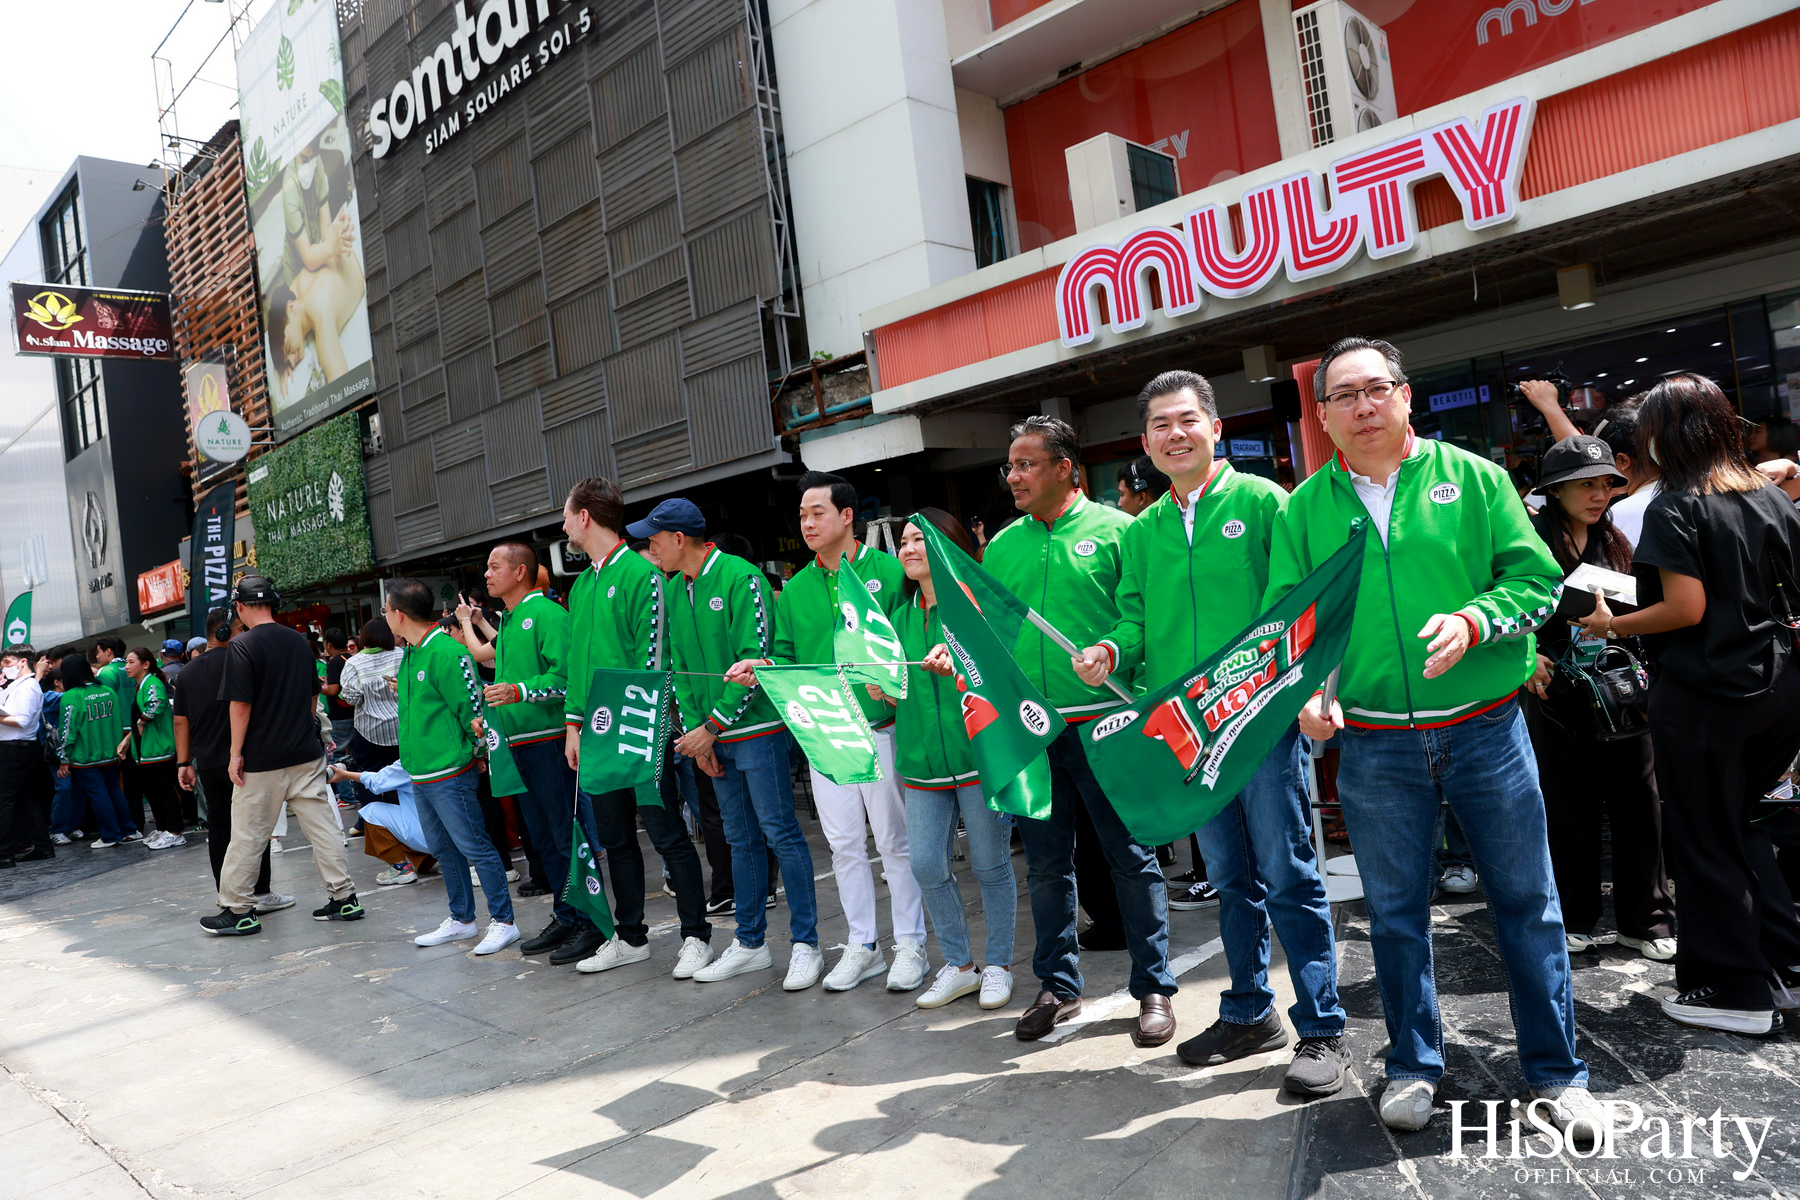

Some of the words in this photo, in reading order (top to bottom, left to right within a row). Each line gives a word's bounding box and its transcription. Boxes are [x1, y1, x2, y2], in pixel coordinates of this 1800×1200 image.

[425, 111, 460, 154] SIAM
[466, 54, 532, 122] SQUARE
[539, 23, 571, 64] SOI
[579, 7, 591, 33] 5
[273, 92, 307, 139] NATURE
[72, 330, 168, 355] Massage
[281, 414, 303, 432] Authentic
[303, 398, 330, 419] Traditional
[330, 390, 343, 405] Thai
[343, 377, 370, 397] Massage
[1233, 444, 1261, 452] FRAGRANCE
[267, 481, 322, 524] NATURE
[1433, 488, 1456, 498] PIZZA
[207, 516, 221, 541] THE
[290, 511, 328, 537] MASSAGE
[1225, 524, 1242, 534] PIZZA
[204, 545, 228, 602] PIZZA
[1261, 620, 1285, 636] 1112
[864, 608, 901, 678] 111
[968, 667, 982, 687] 1112
[87, 700, 113, 722] 1112
[596, 710, 607, 730] PIZZA
[618, 684, 659, 762] 1112
[798, 685, 874, 755] 1112
[1022, 703, 1045, 730] PIZZA
[1024, 716, 1036, 730] COMPANY
[1096, 715, 1131, 736] PIZZA
